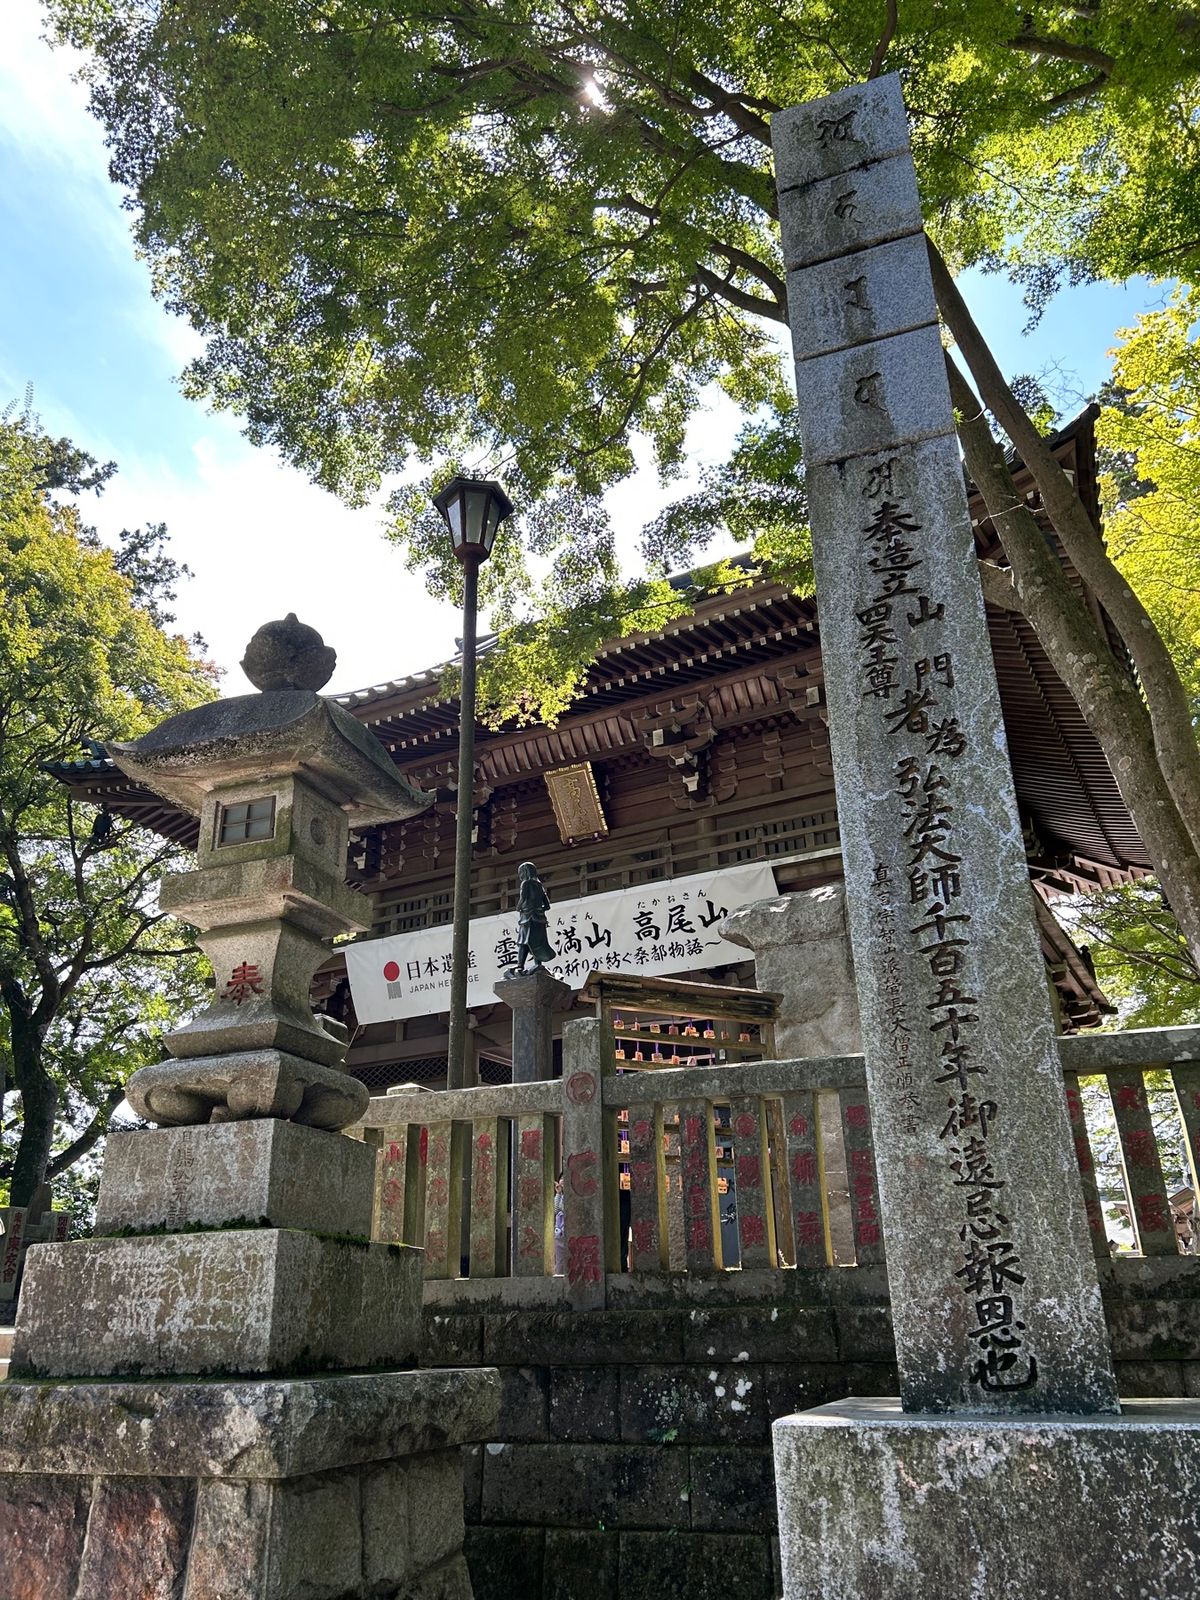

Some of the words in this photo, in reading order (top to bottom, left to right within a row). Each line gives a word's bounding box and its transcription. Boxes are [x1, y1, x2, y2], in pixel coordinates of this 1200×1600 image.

[637, 889, 707, 909] たかおさん
[494, 922, 612, 969] 霊満山
[633, 900, 729, 941] 高尾山
[409, 981, 436, 994] JAPAN
